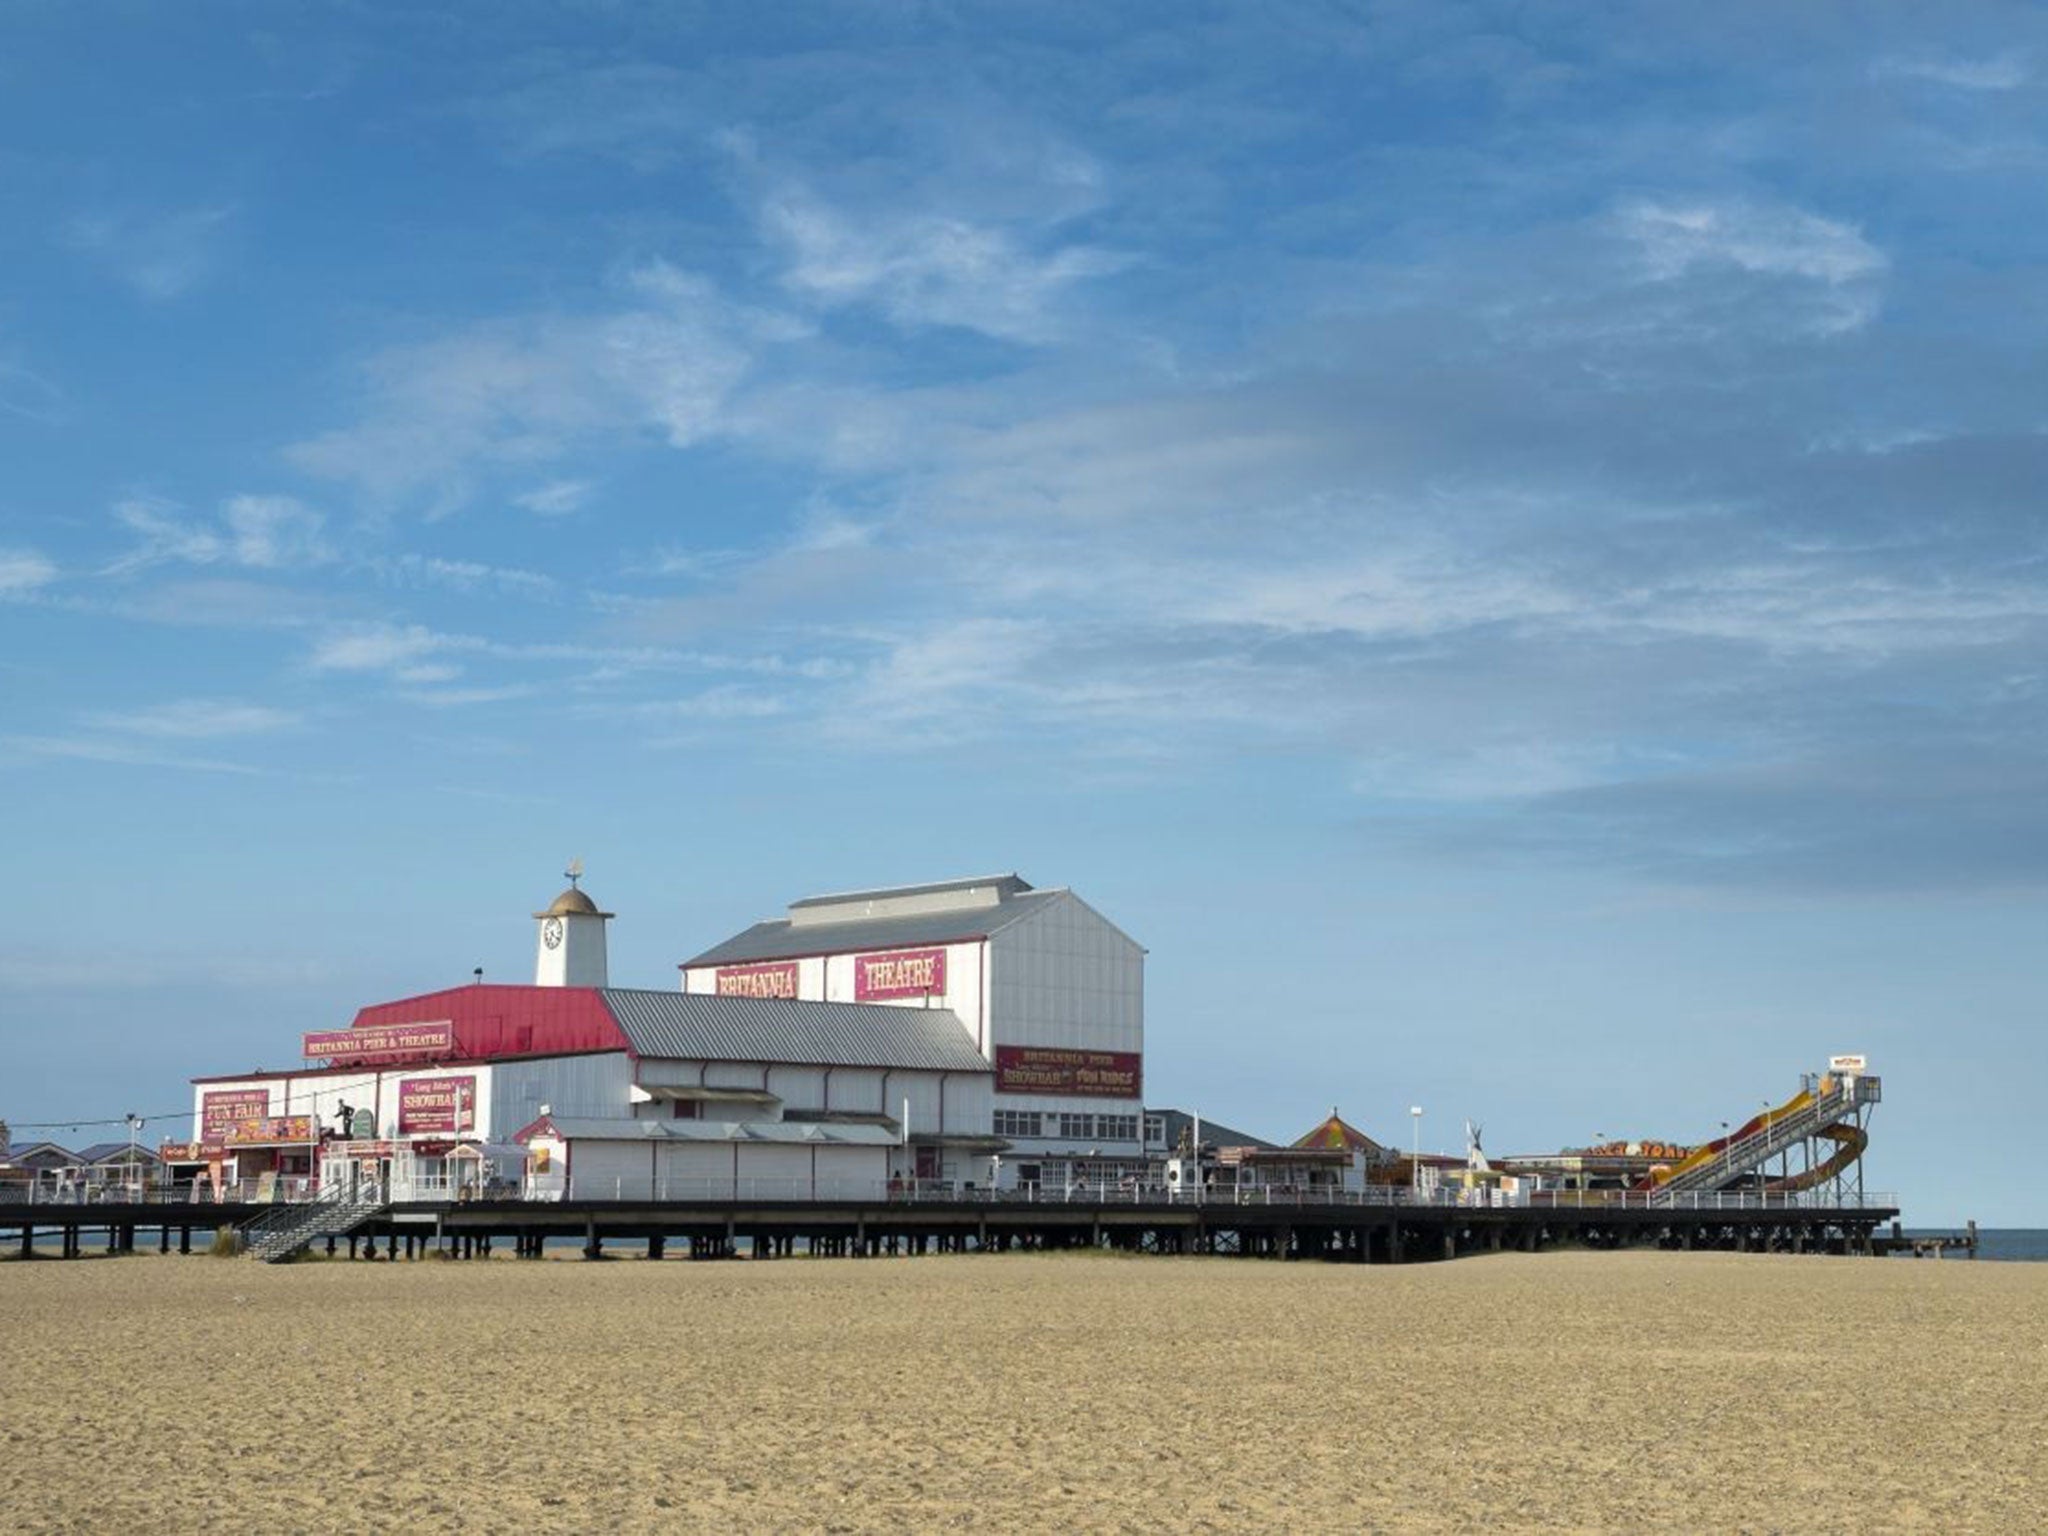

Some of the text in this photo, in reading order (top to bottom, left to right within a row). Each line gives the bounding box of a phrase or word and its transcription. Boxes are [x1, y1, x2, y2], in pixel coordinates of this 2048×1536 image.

[718, 968, 794, 998] BRITANNIA
[863, 955, 935, 991] THEATRE
[308, 1039, 361, 1054] BRITANNIA
[363, 1037, 387, 1049] PIER
[399, 1033, 446, 1047] THEATRE
[1004, 1068, 1061, 1085] SHOWBAR
[207, 1103, 262, 1120] FUN FAIR
